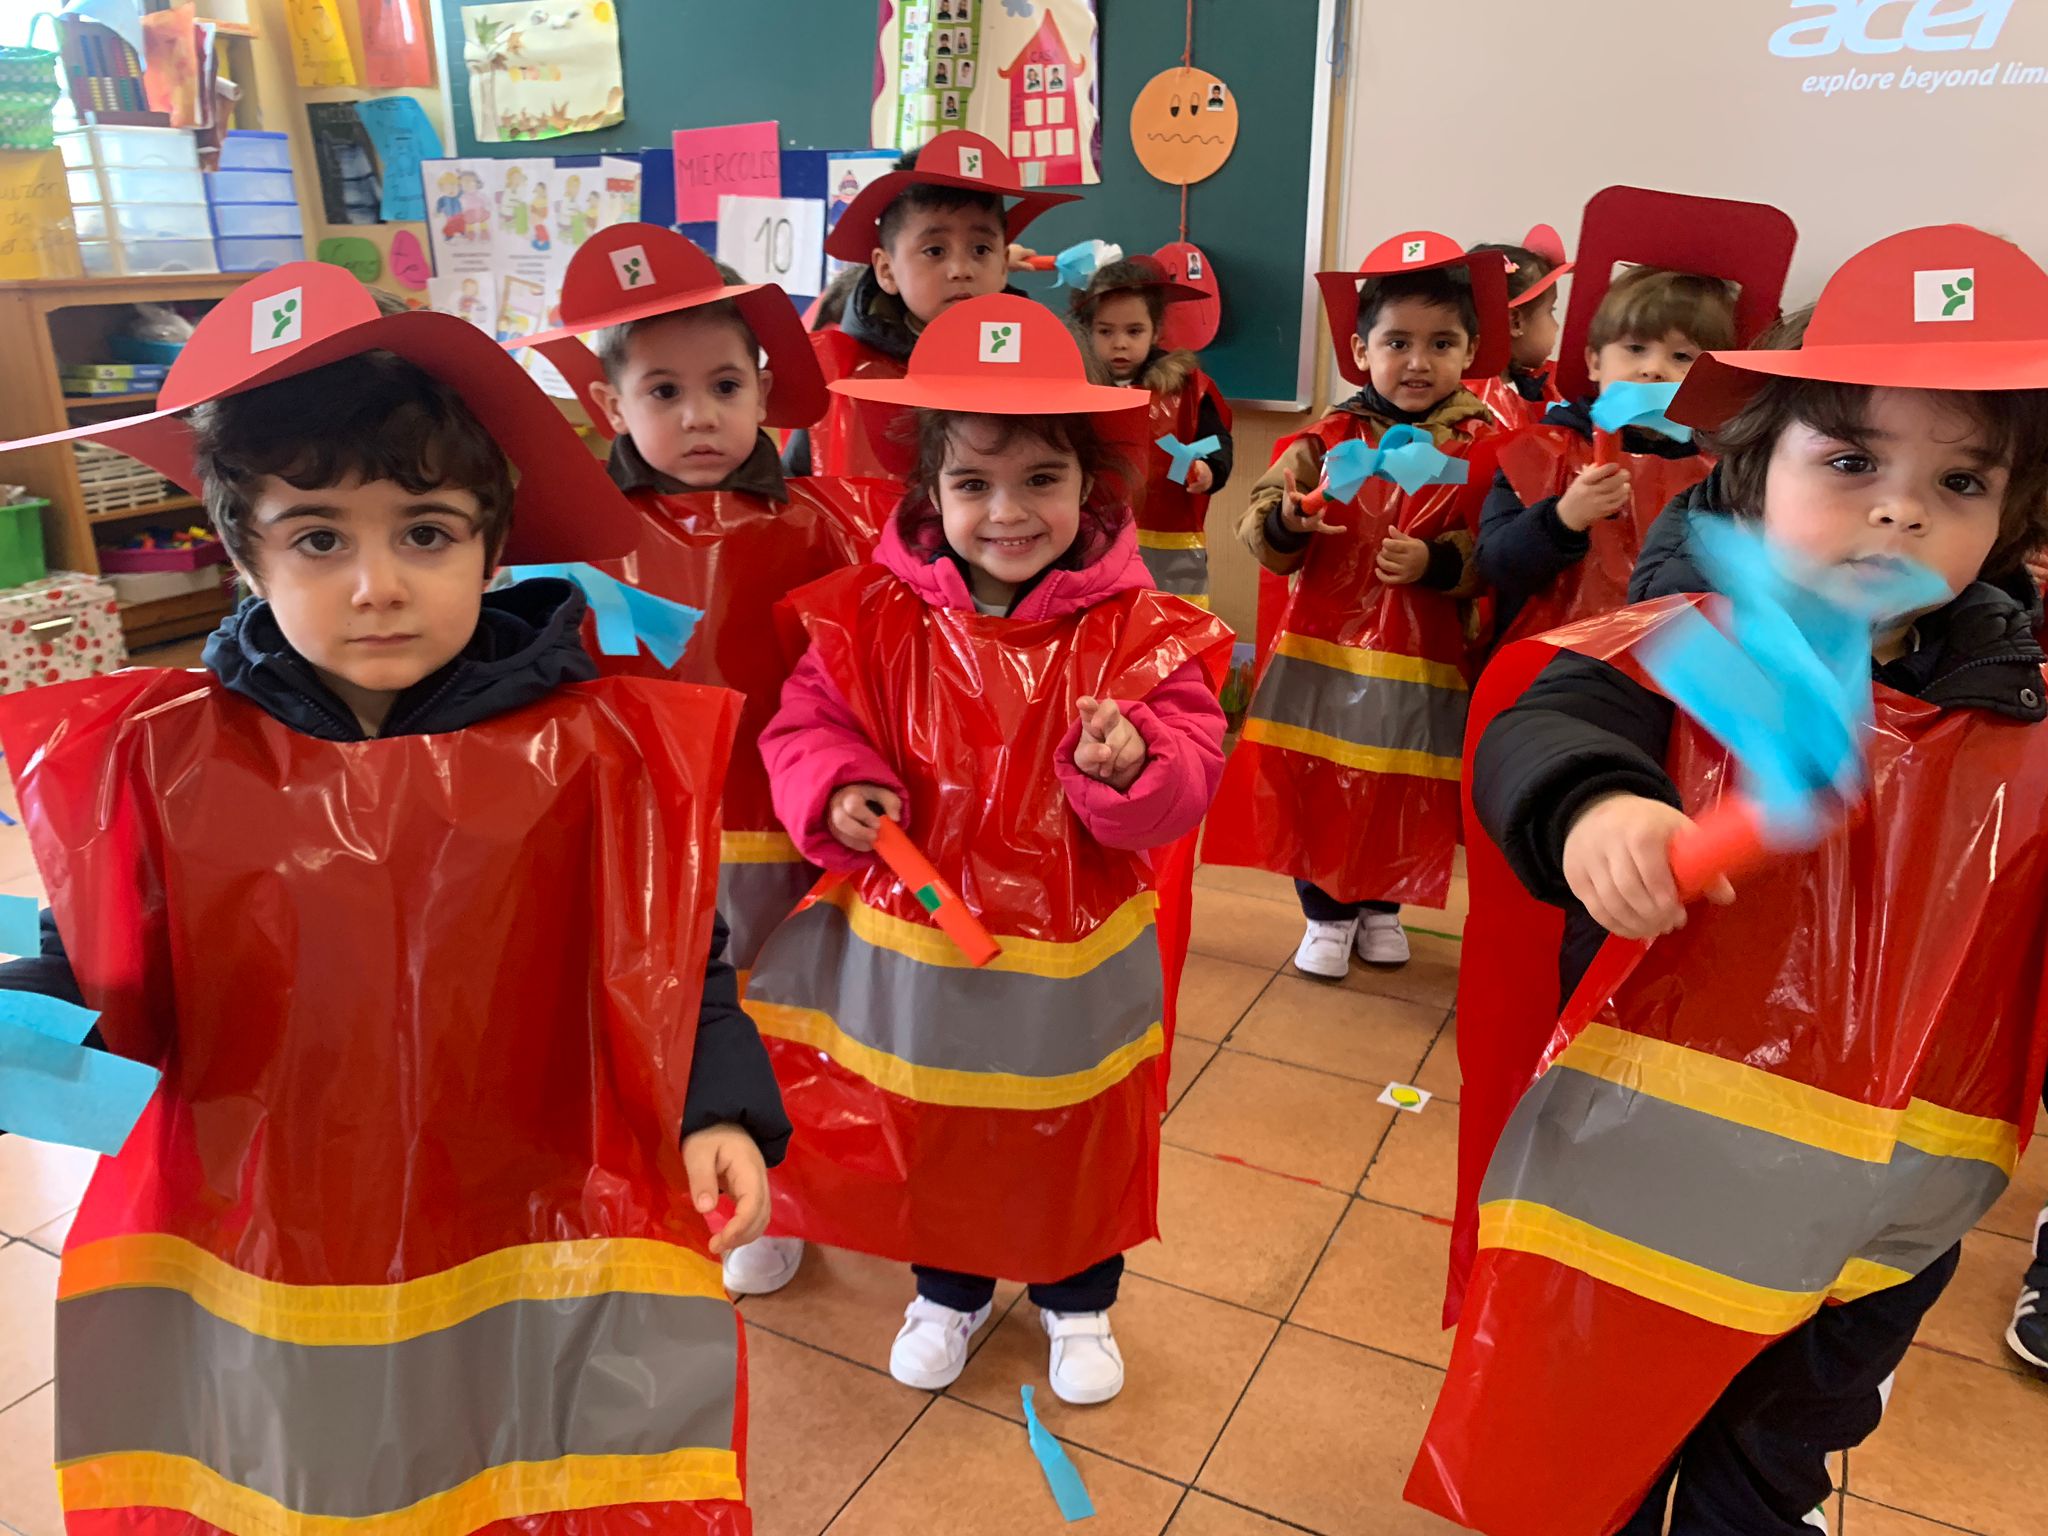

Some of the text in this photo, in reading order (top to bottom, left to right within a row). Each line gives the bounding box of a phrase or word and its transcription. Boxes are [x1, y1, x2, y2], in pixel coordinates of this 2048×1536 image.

[1768, 0, 2014, 57] acer
[1802, 62, 2048, 97] explore beyond lim
[755, 216, 794, 274] 10
